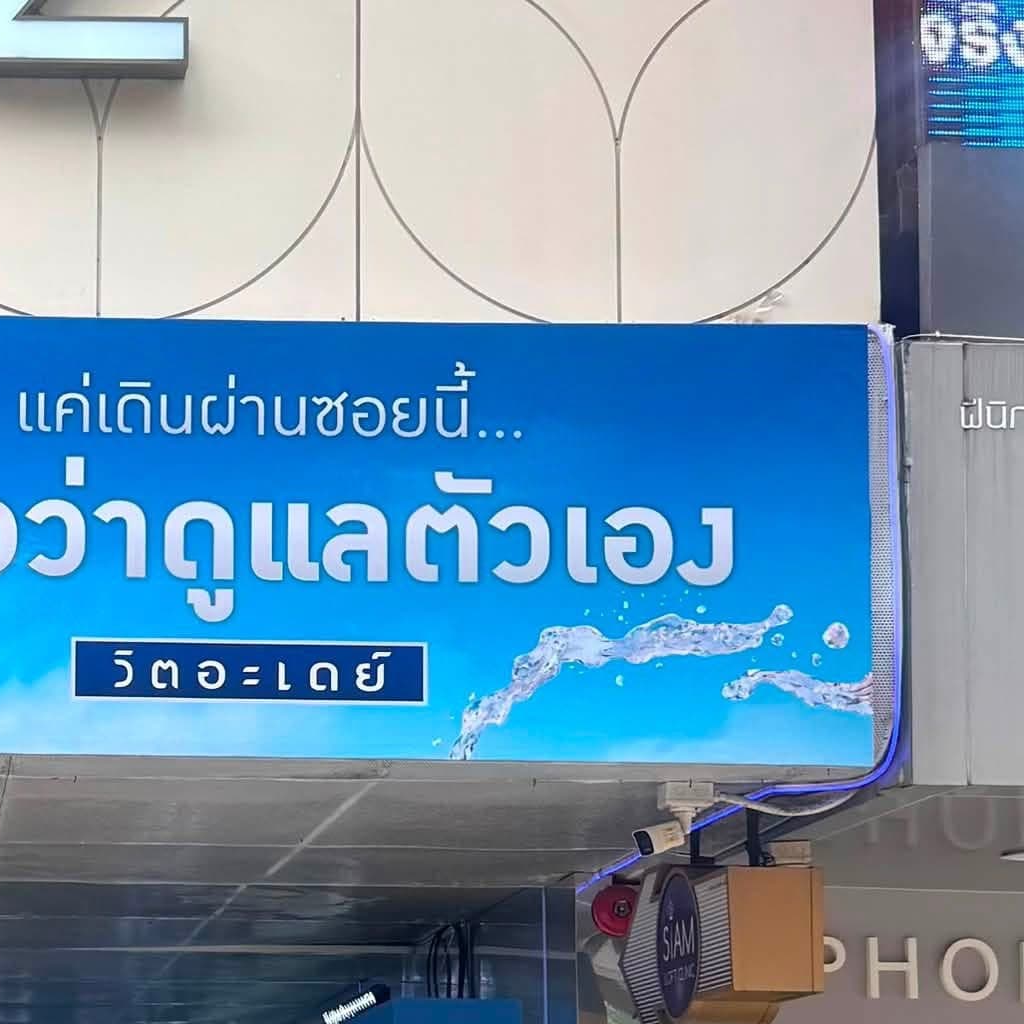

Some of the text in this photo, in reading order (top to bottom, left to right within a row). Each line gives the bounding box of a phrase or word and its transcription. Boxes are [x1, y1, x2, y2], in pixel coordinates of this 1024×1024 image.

[18, 361, 524, 439] แค่เดินผ่านซอยนี้...
[112, 649, 393, 692] วิตอะเดย์
